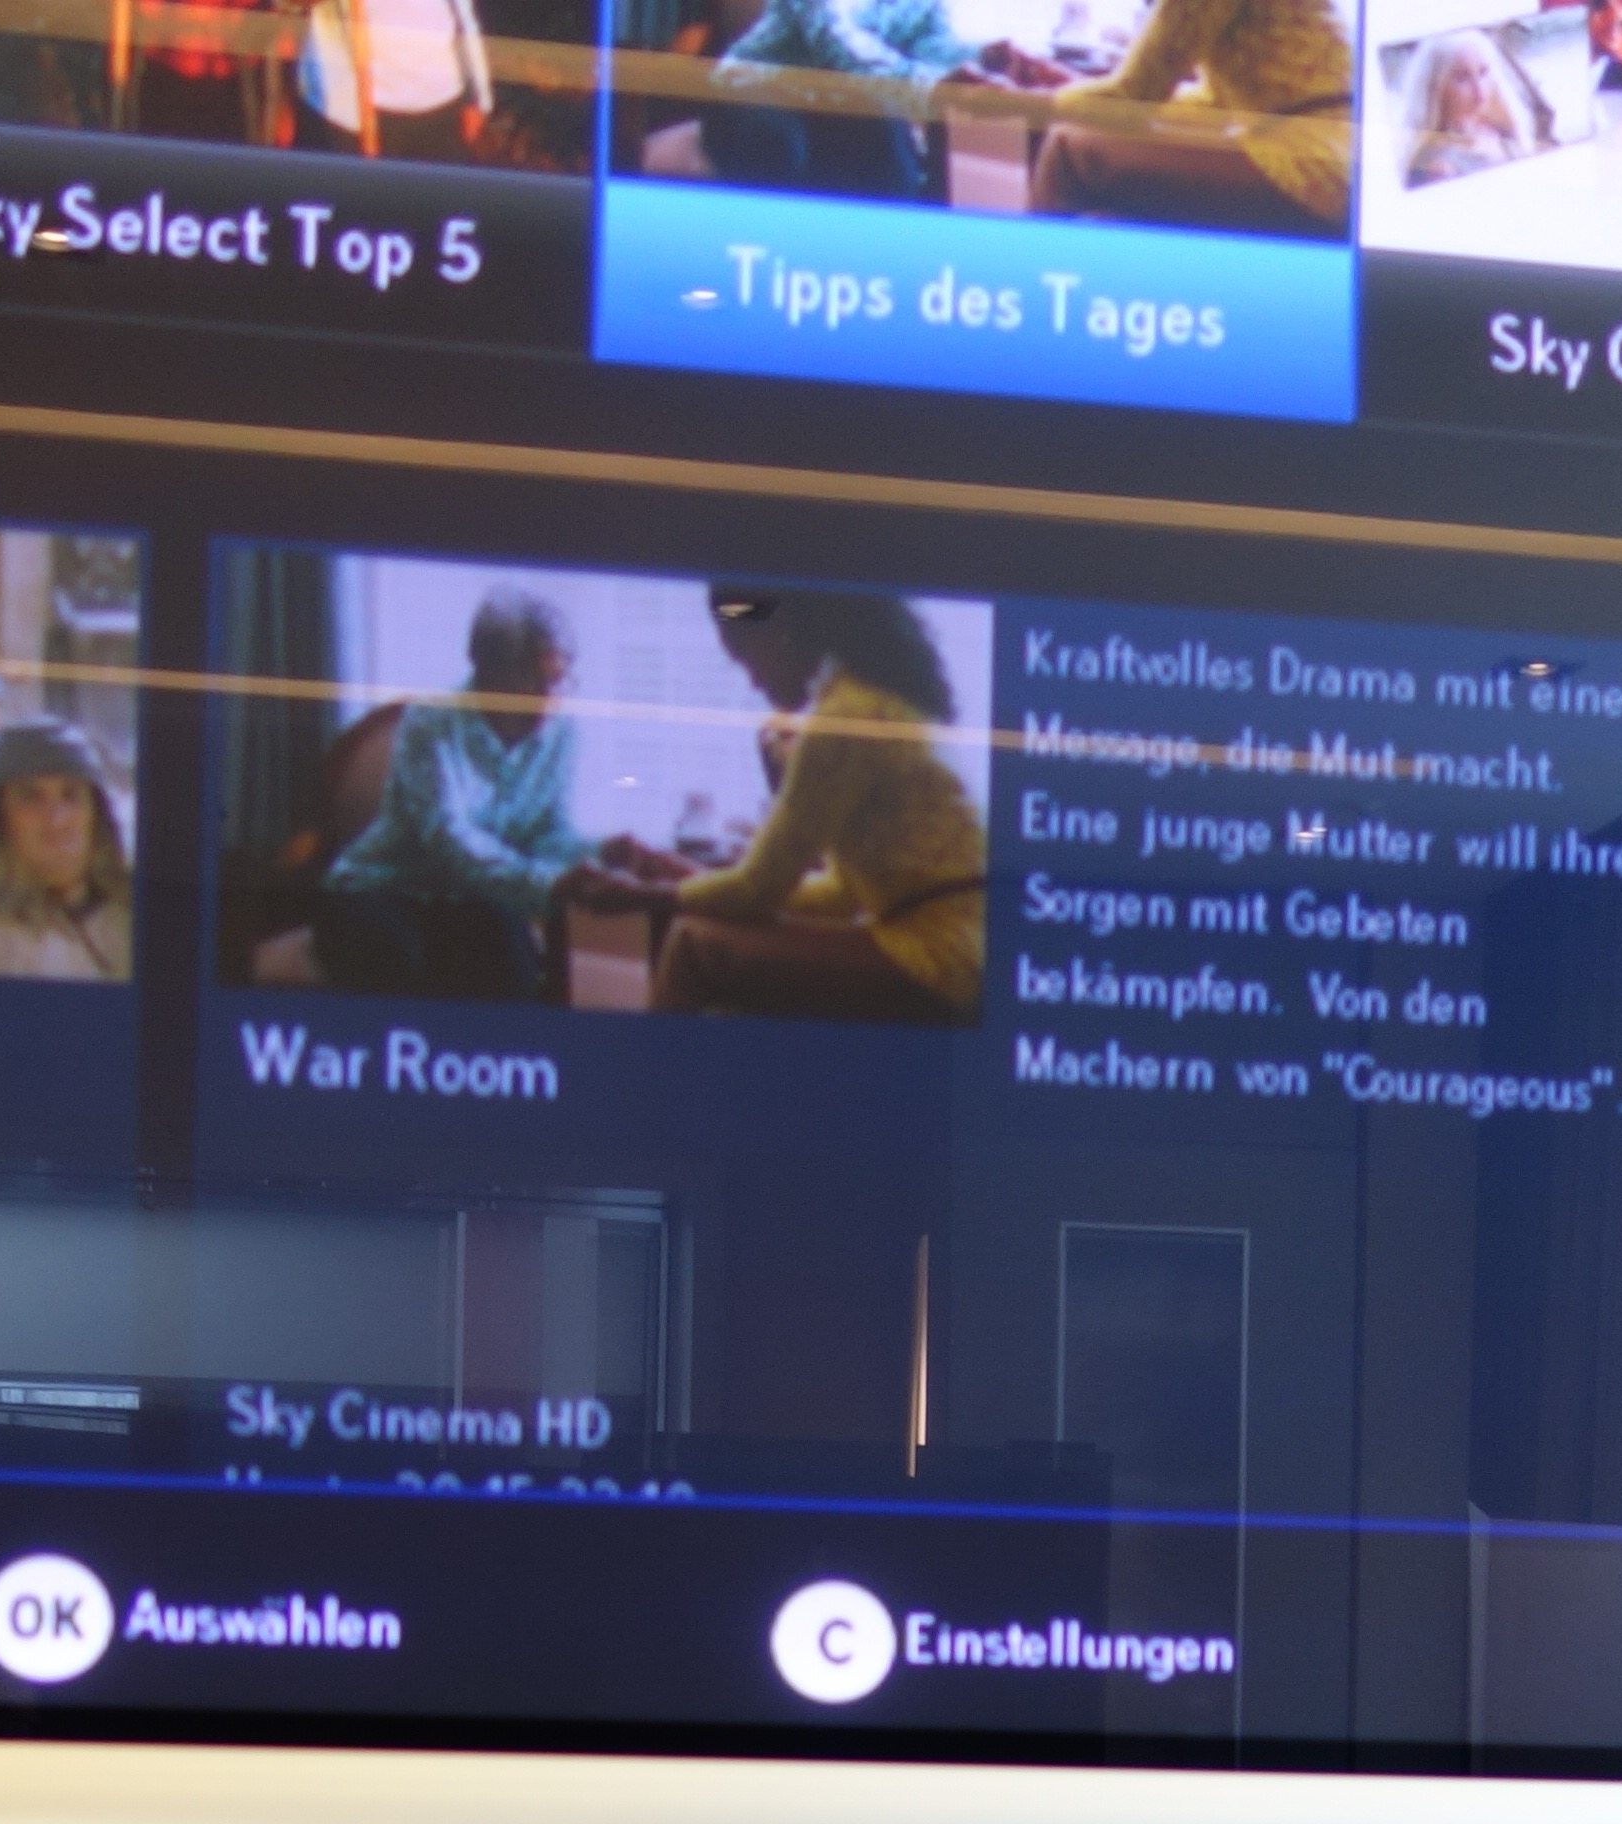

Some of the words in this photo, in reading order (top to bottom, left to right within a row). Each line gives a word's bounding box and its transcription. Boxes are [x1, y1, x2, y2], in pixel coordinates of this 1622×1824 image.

[60, 184, 269, 266] Select
[288, 204, 415, 290] Top
[438, 217, 481, 284] 5
[727, 244, 893, 330] Tipps
[919, 265, 1023, 330] des
[1040, 272, 1226, 357] Tages
[1489, 313, 1589, 391] Sky
[1024, 629, 1254, 692] Kraftvolles
[1268, 647, 1417, 704] Drama
[1435, 670, 1515, 712] mit
[1225, 727, 1293, 776] die
[1309, 730, 1397, 779] Mut
[1415, 745, 1564, 794] macht.
[1021, 789, 1119, 844] Eine
[1141, 808, 1273, 865] junge
[1287, 808, 1433, 864] Mutter
[1456, 825, 1537, 870] will
[1024, 872, 1176, 938] Sorgen
[1190, 892, 1270, 936] mit
[1284, 889, 1468, 947] Gebeten
[1017, 952, 1284, 1022] bekämpfen.
[1307, 970, 1389, 1023] Von
[1402, 977, 1488, 1027] den
[239, 1020, 371, 1090] War
[384, 1027, 560, 1101] Room
[1015, 1034, 1214, 1092] Machern
[1235, 1058, 1310, 1099] von
[225, 1385, 313, 1450] Sky
[327, 1388, 523, 1447] Cinema
[535, 1395, 613, 1452] HD
[9, 1592, 85, 1641] OK
[124, 1588, 402, 1650] Auswählen
[817, 1616, 856, 1667] C
[905, 1611, 1235, 1684] Einstellungen
